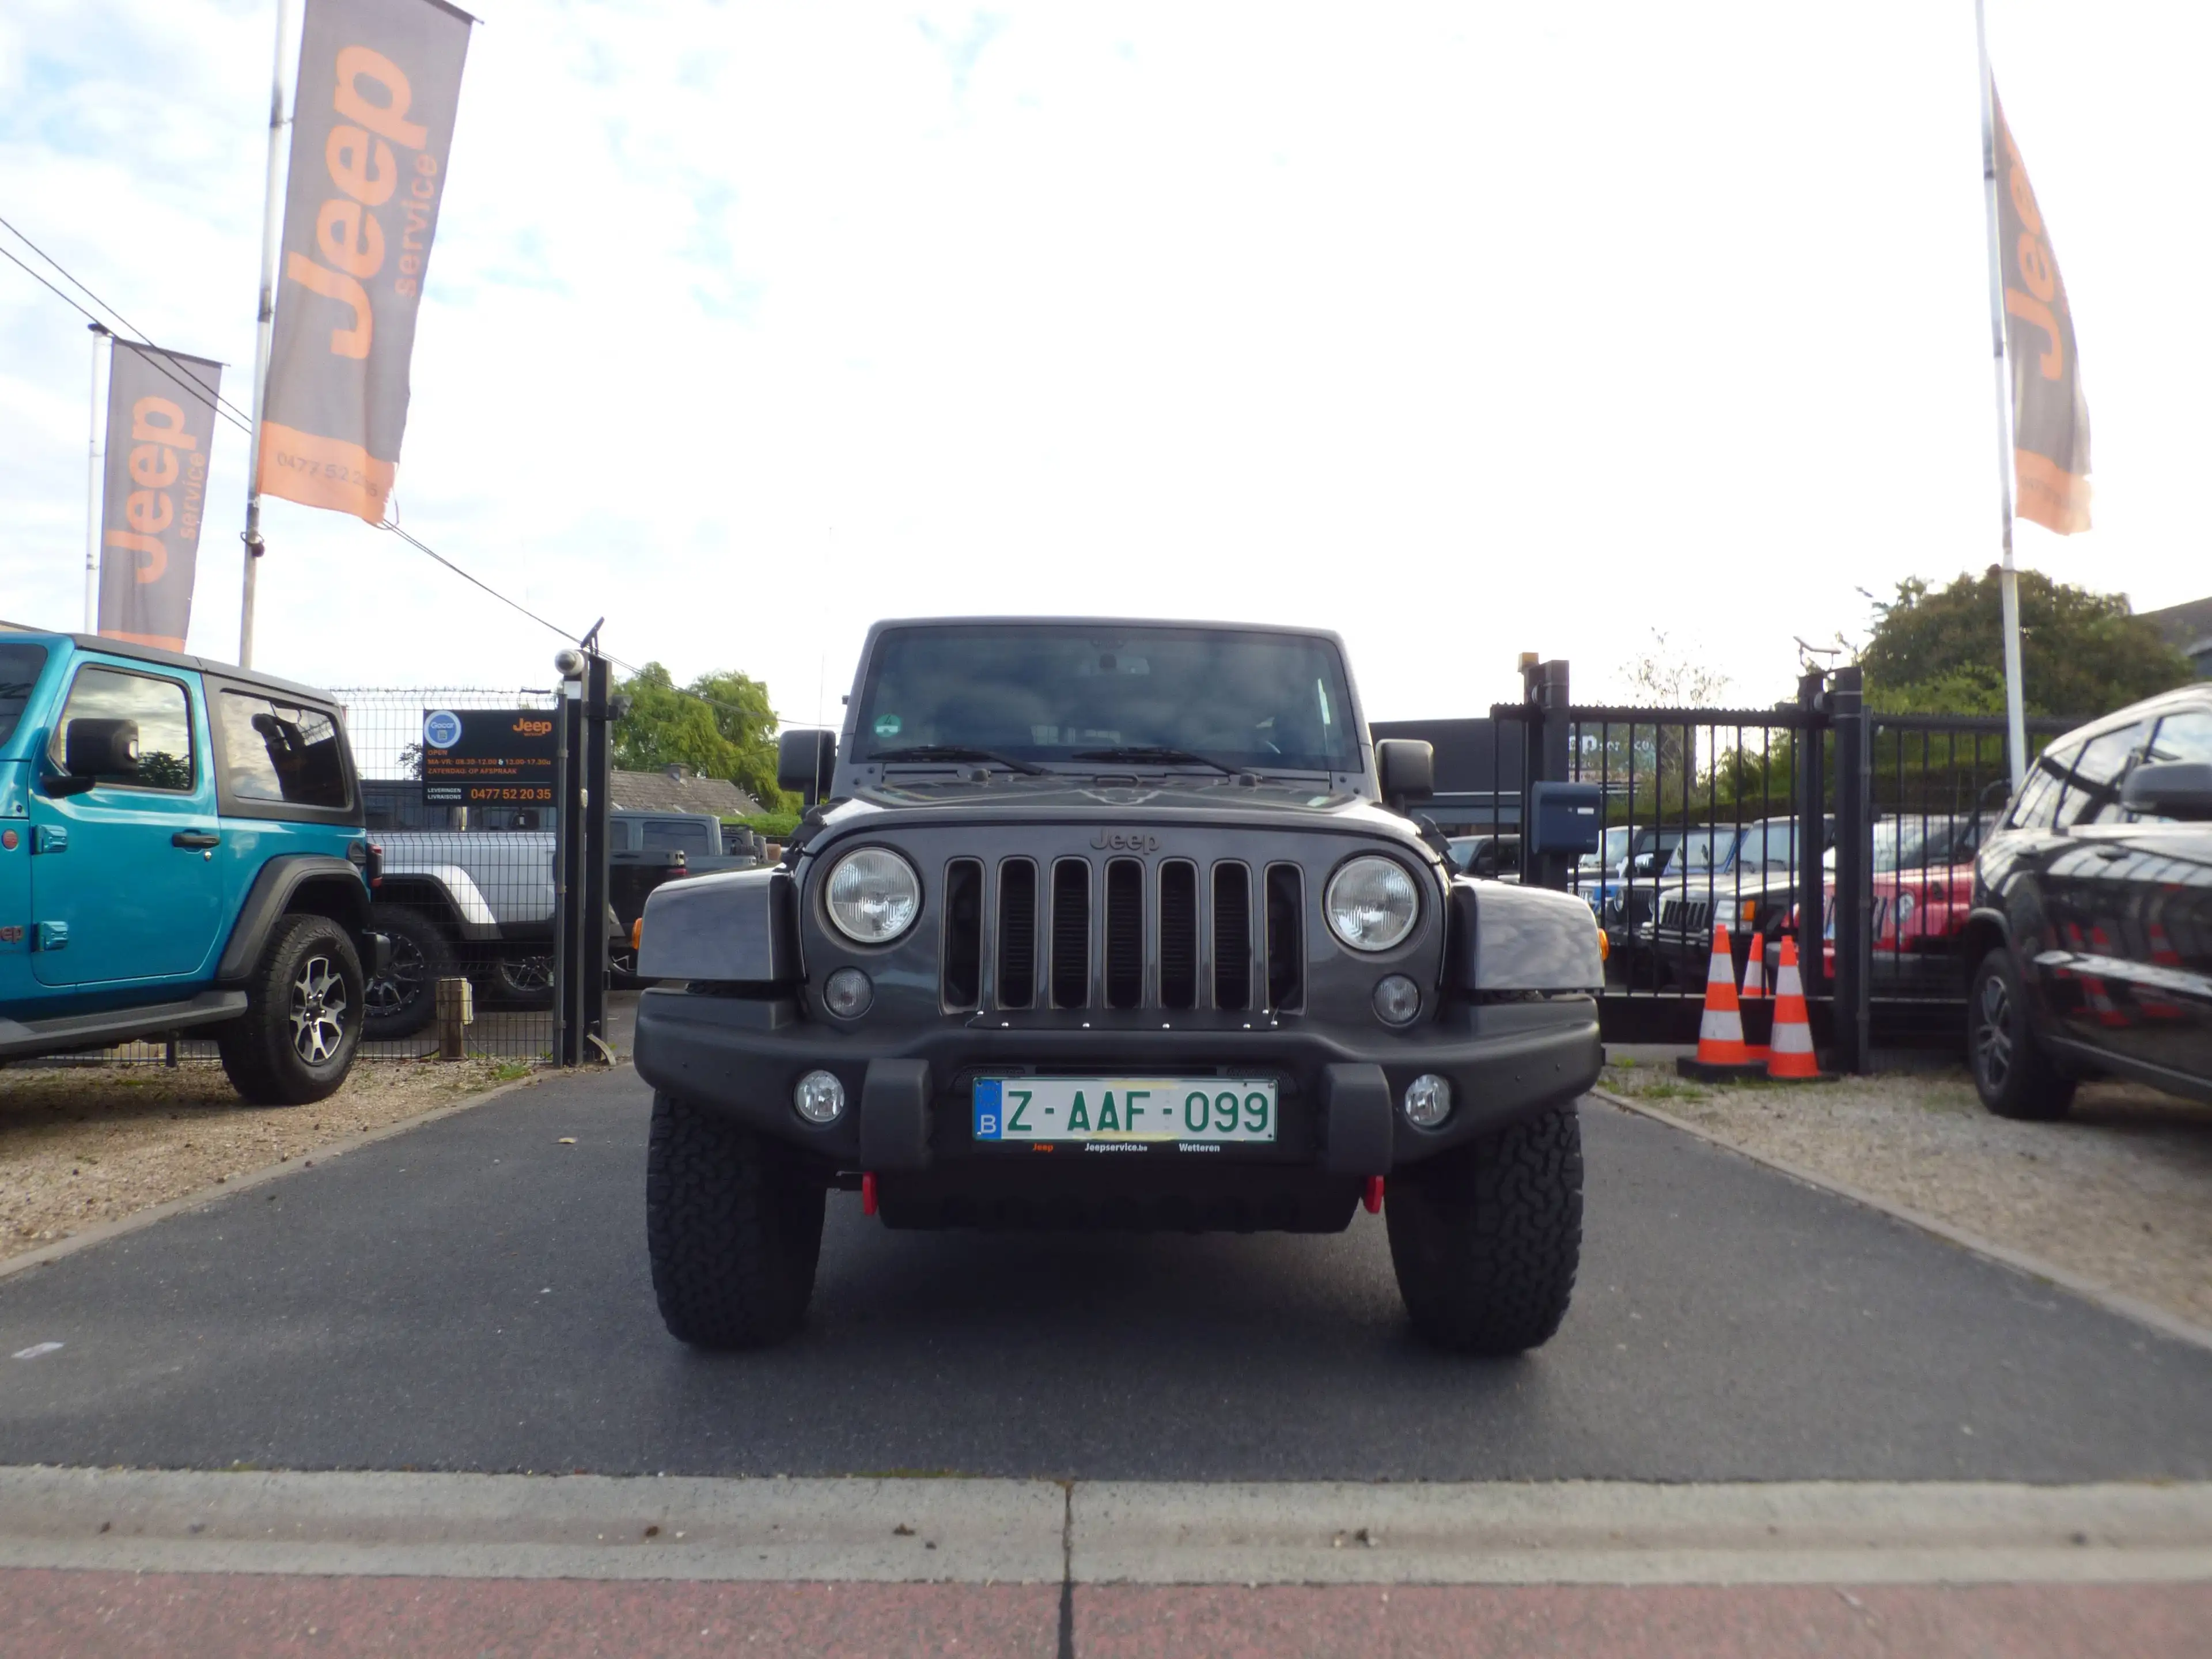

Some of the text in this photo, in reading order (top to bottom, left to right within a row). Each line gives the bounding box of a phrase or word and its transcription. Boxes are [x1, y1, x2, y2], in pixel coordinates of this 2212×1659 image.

[287, 45, 429, 359] Jeep
[395, 154, 438, 298] service
[106, 396, 196, 584] Jeep
[180, 452, 205, 540] service
[513, 718, 552, 734] Jeep
[471, 789, 551, 799] 0477 52 20 35
[1090, 827, 1160, 855] Jeep
[980, 1115, 997, 1134] B
[1007, 1090, 1268, 1132] Z-AAF-099
[1032, 1142, 1220, 1153] Jeep Jeepservice.be Wetteren
